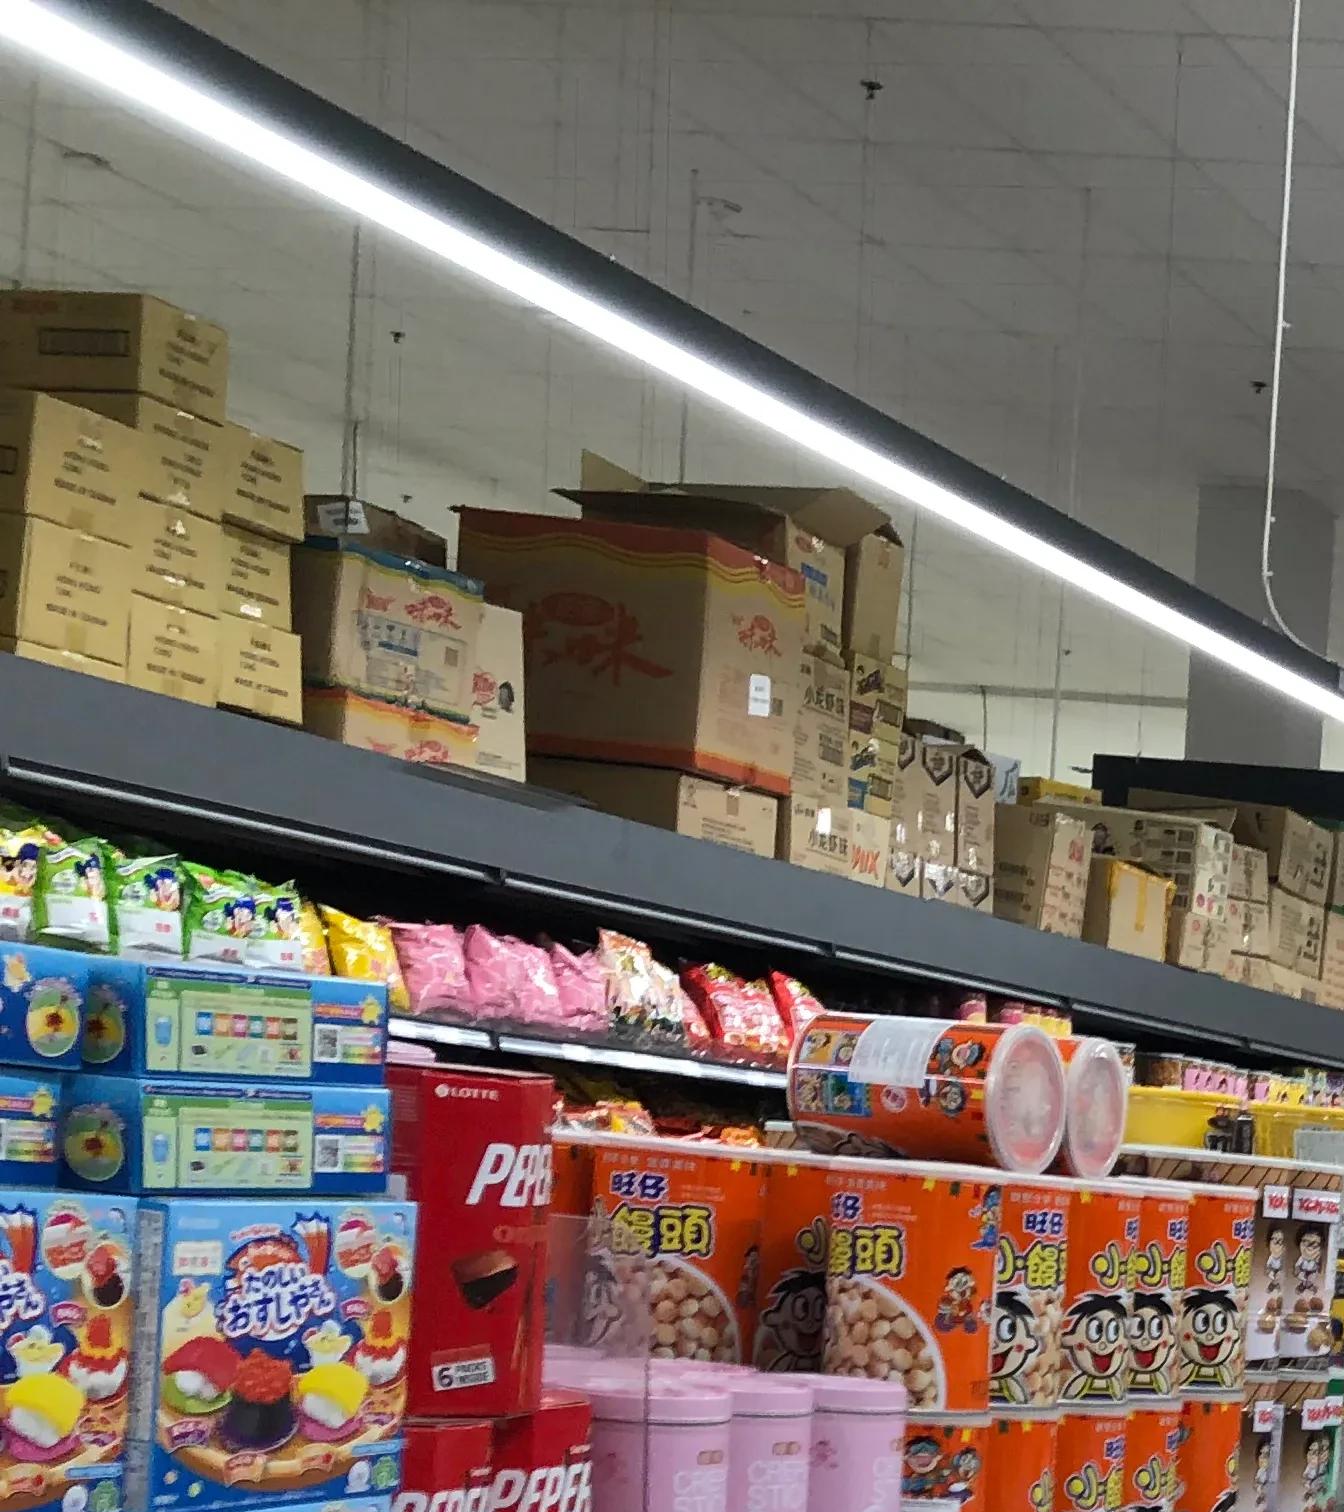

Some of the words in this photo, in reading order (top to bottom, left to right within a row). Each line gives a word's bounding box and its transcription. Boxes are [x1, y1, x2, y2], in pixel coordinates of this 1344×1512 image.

[450, 1086, 499, 1101] LOTTE
[611, 1170, 669, 1200] 旺仔
[437, 1366, 454, 1388] 6
